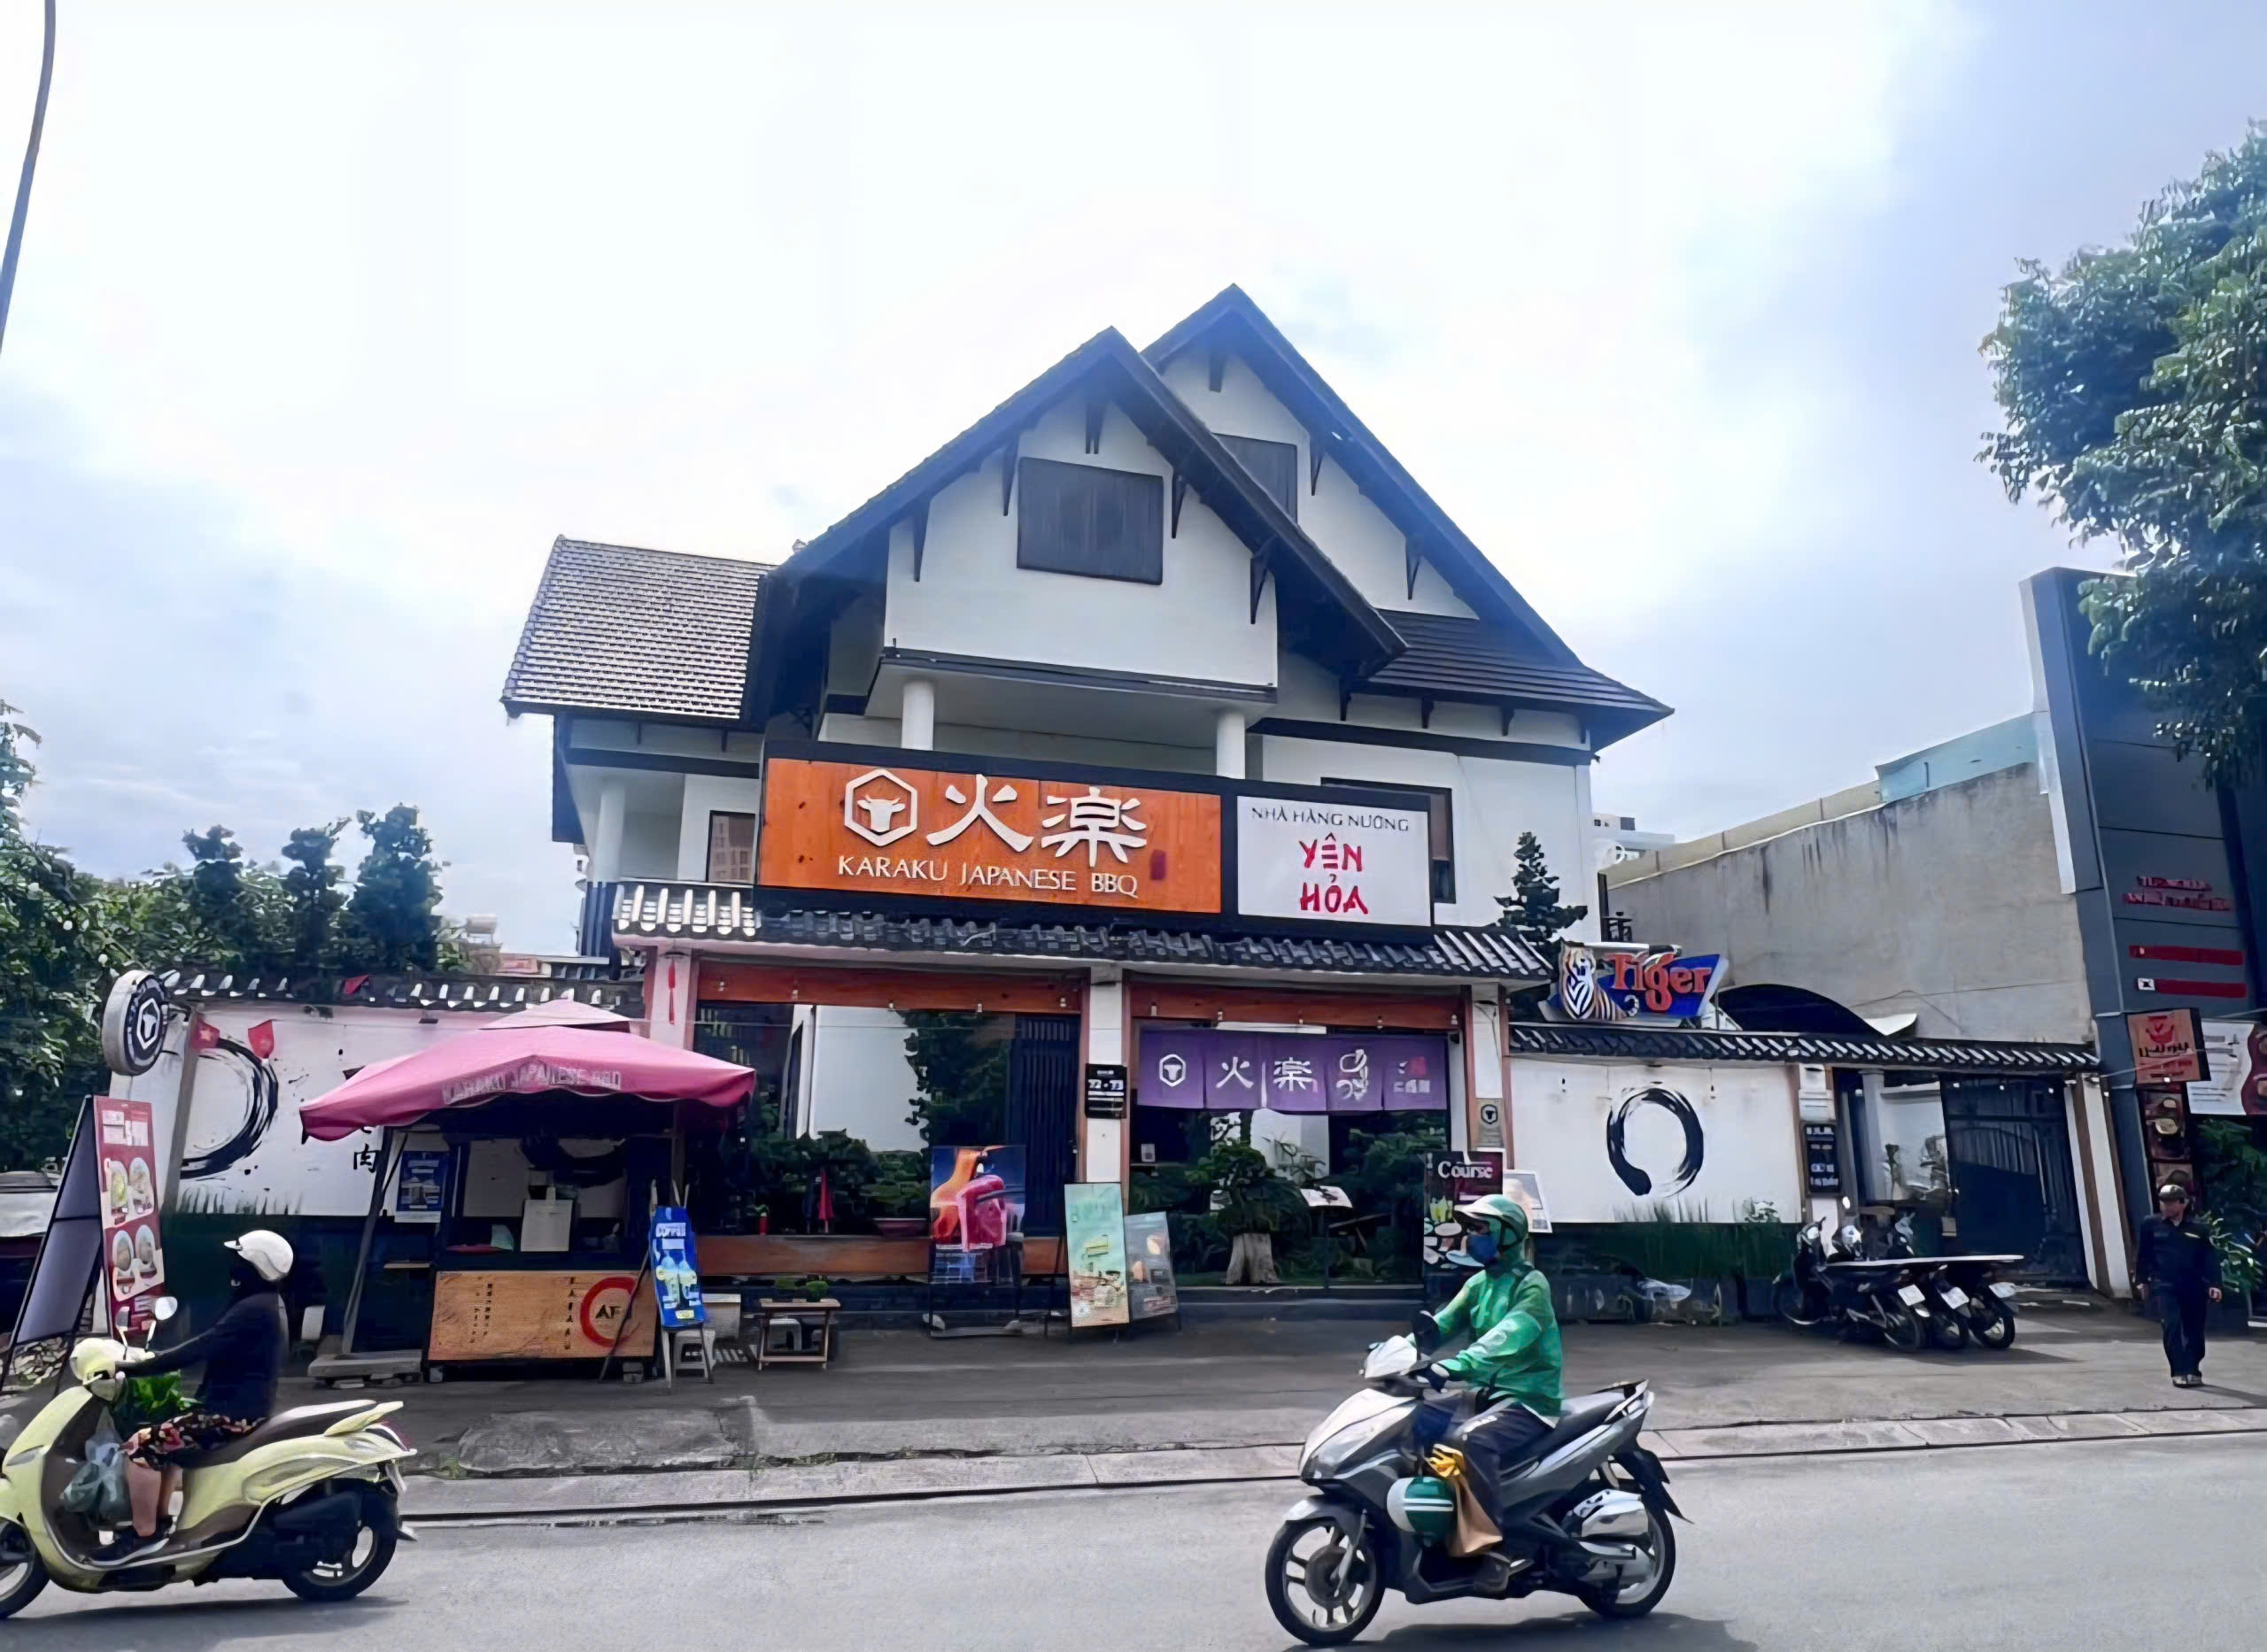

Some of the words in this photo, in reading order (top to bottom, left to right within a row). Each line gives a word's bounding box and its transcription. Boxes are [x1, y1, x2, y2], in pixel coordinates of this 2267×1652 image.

[926, 774, 1147, 868] 火楽
[1299, 832, 1362, 872] YÊN
[838, 855, 948, 881] KARAKU
[959, 862, 1077, 891] JAPANESE
[1090, 873, 1139, 899] BBQ
[1300, 874, 1368, 915] HỎA
[1603, 951, 1713, 1014] Tiger
